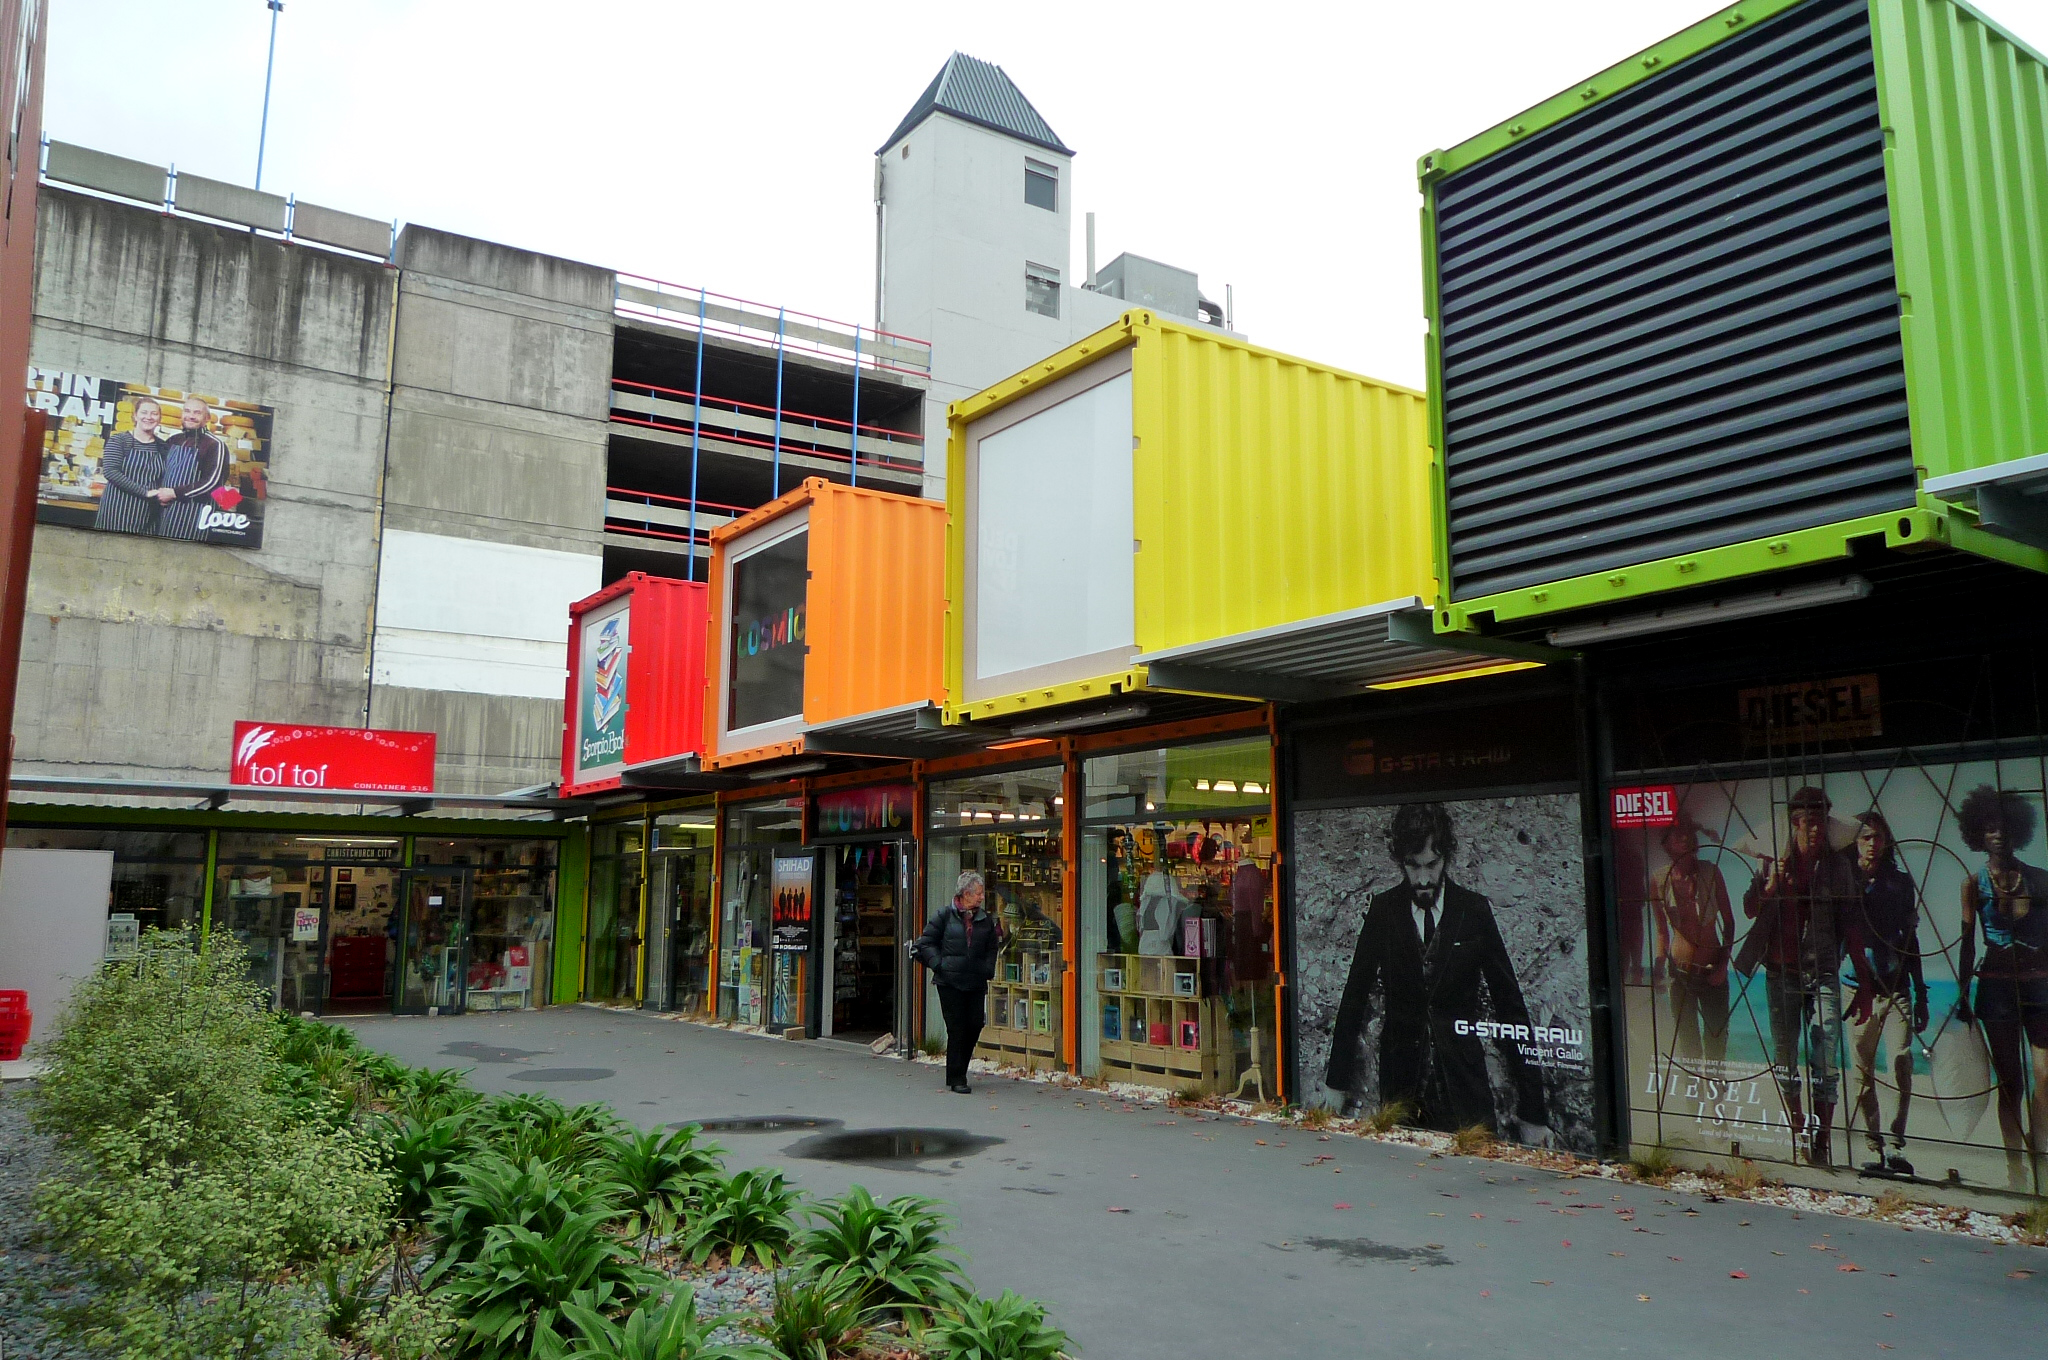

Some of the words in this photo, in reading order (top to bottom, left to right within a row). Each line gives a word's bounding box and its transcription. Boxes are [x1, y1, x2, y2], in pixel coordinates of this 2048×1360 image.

[198, 505, 250, 530] love
[738, 604, 805, 658] COSMIC
[582, 737, 609, 762] Scorpio
[250, 762, 286, 785] toi
[293, 764, 328, 787] toi
[354, 782, 406, 791] CONTAINER
[1616, 791, 1673, 818] DIESEL
[326, 848, 375, 858] CHRISTCHURCH
[377, 848, 392, 858] CITY
[777, 858, 810, 872] SHIHAD
[1454, 1019, 1530, 1041] G-STAR
[1534, 1026, 1583, 1045] RAW
[1517, 1043, 1553, 1058] Vincent
[1556, 1047, 1583, 1061] Gallo
[1645, 1072, 1760, 1104] DIESEL
[1695, 1102, 1820, 1137] ISLAND
